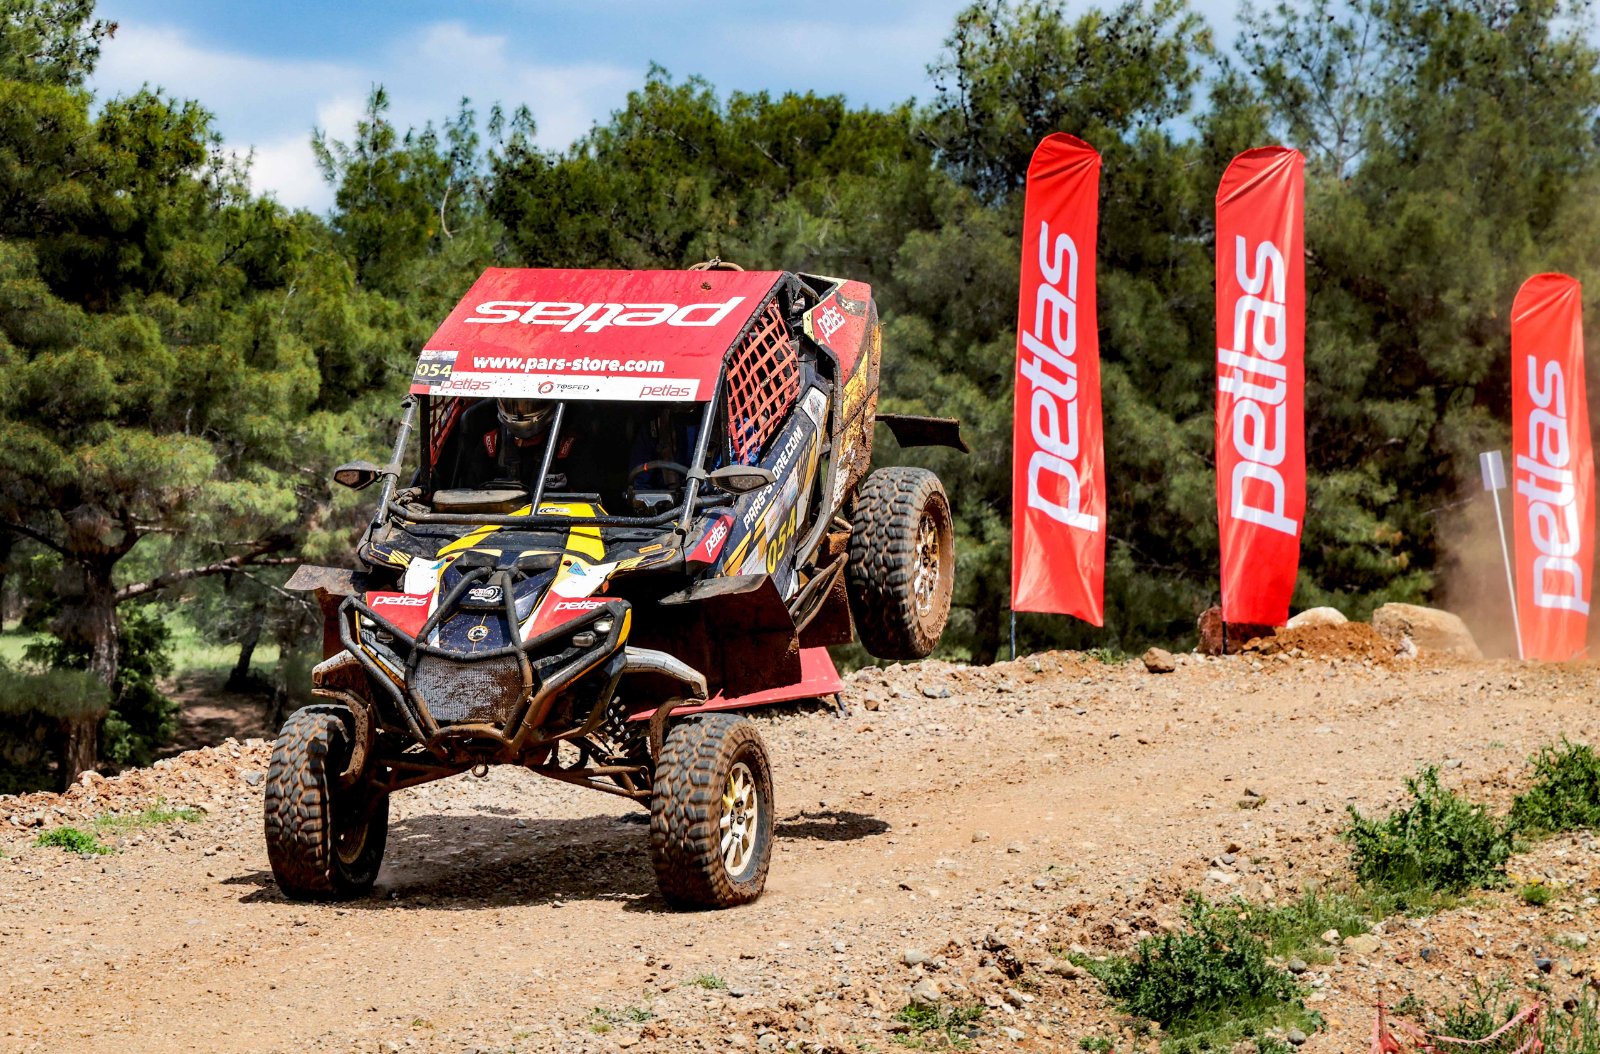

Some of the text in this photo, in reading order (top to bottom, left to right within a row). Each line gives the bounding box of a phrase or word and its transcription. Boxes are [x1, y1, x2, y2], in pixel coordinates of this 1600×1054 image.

[464, 296, 746, 332] petlas
[817, 305, 846, 344] petlas
[416, 363, 452, 377] 054
[473, 356, 665, 373] www.pars-store.com
[1020, 220, 1099, 532] petlas
[440, 377, 492, 391] petlas
[639, 384, 691, 398] petlas
[1217, 234, 1299, 536] petlas
[743, 426, 804, 530] PARS-SORE.COM
[1514, 355, 1590, 615] petlas
[705, 519, 728, 557] petlas
[767, 505, 797, 574] 054
[372, 595, 428, 607] petlas
